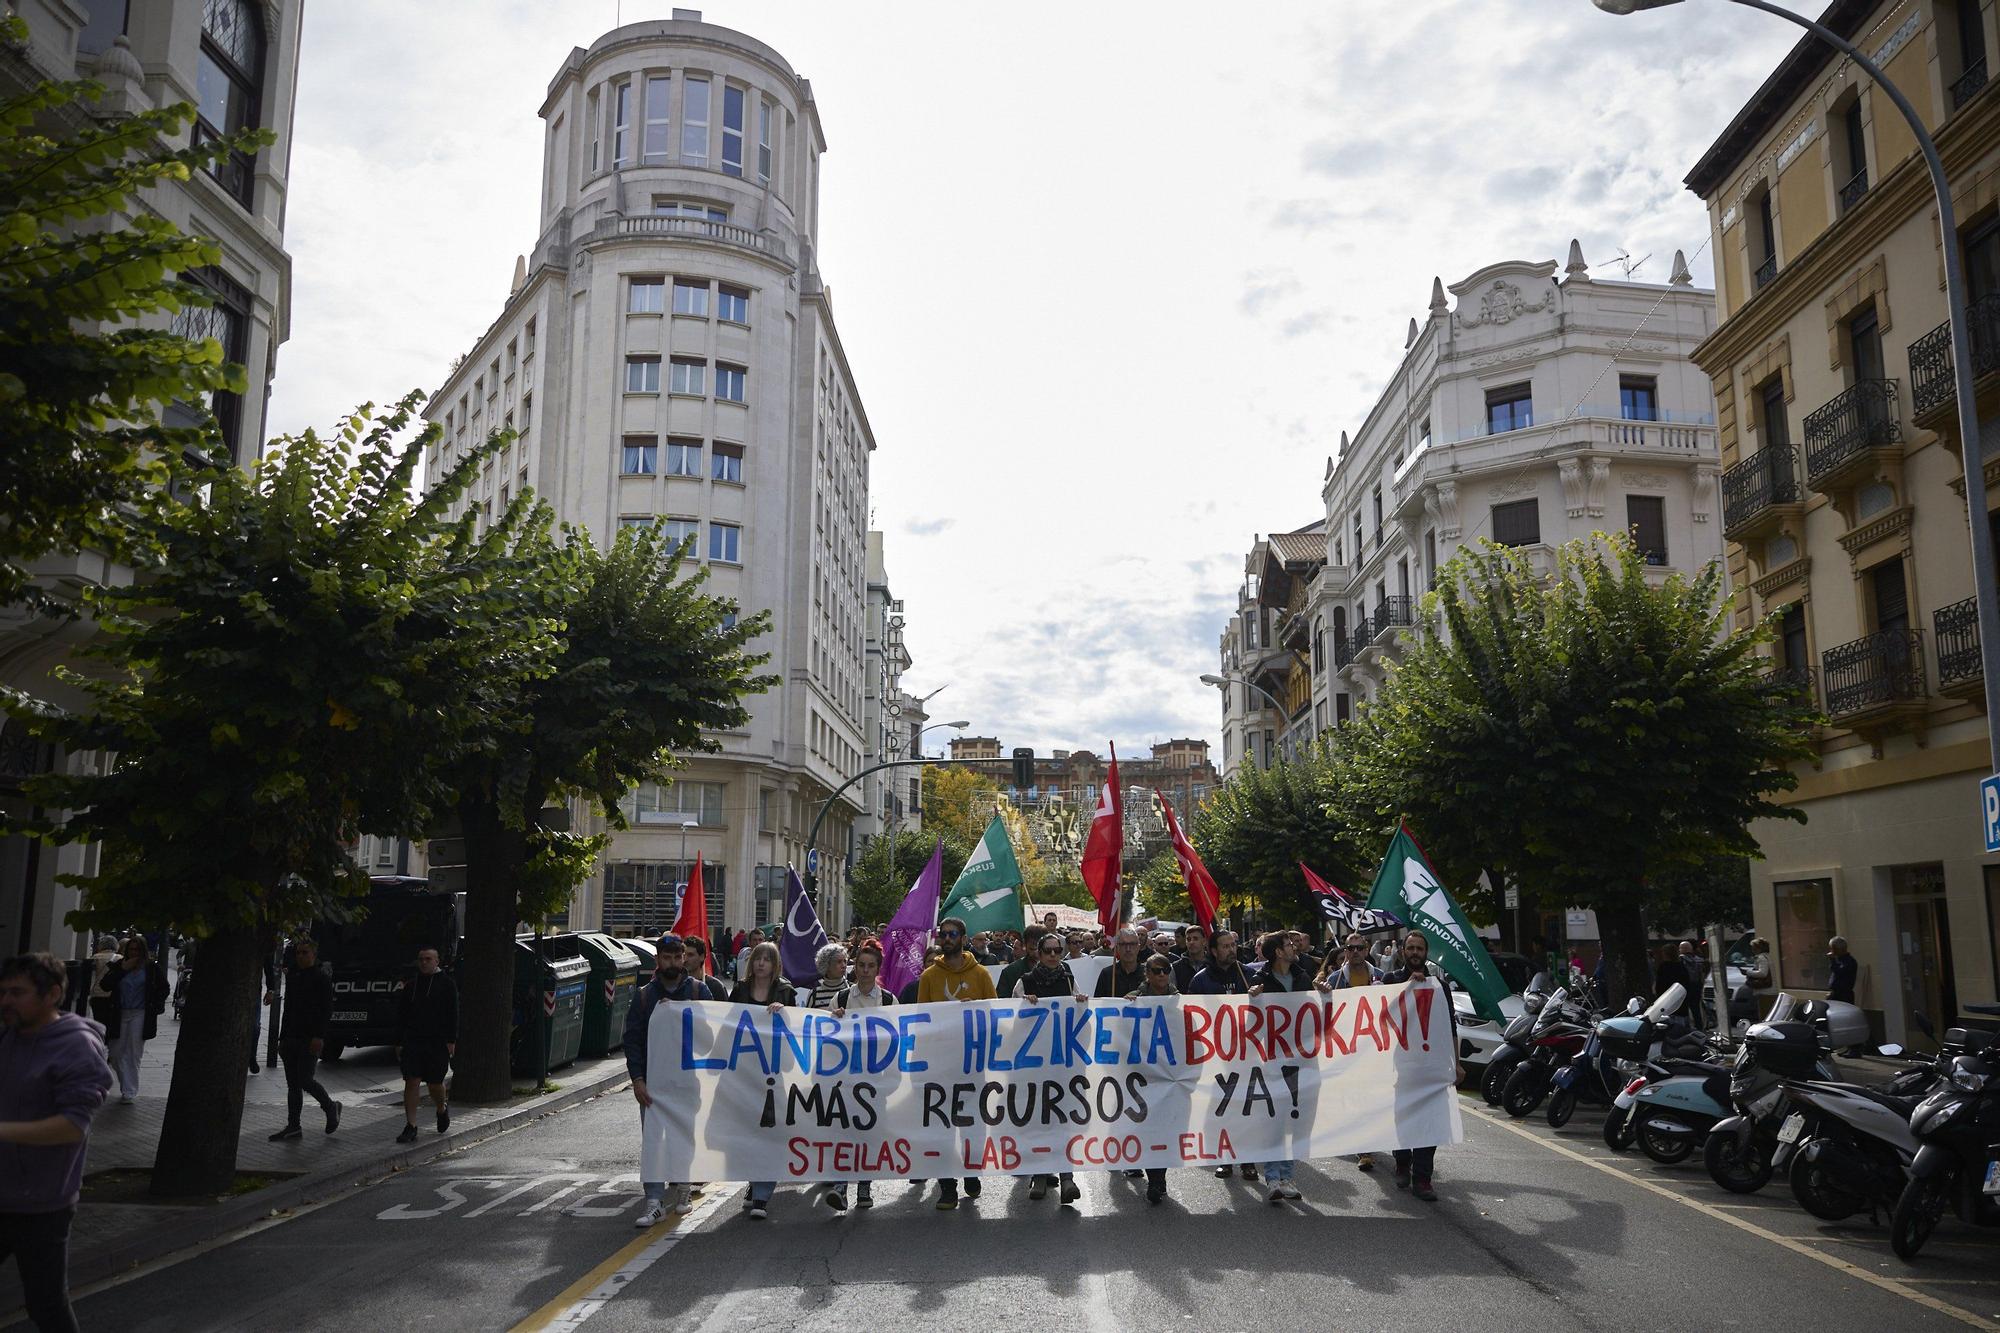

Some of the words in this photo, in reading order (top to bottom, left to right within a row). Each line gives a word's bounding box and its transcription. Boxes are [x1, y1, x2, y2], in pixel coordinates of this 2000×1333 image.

[890, 599, 904, 675] HOTEL
[1985, 785, 2000, 843] P
[332, 981, 406, 993] OLICIA
[1183, 988, 1435, 1066] BORROKAN!
[759, 1077, 878, 1131] ¡MÁS
[922, 1070, 1148, 1130] RECURSOS
[1214, 1065, 1300, 1119] YA!
[788, 1136, 913, 1176] STEILAS
[963, 1135, 1022, 1171] LAB
[1065, 1134, 1142, 1166] CCOO
[1179, 1128, 1237, 1161] ELA
